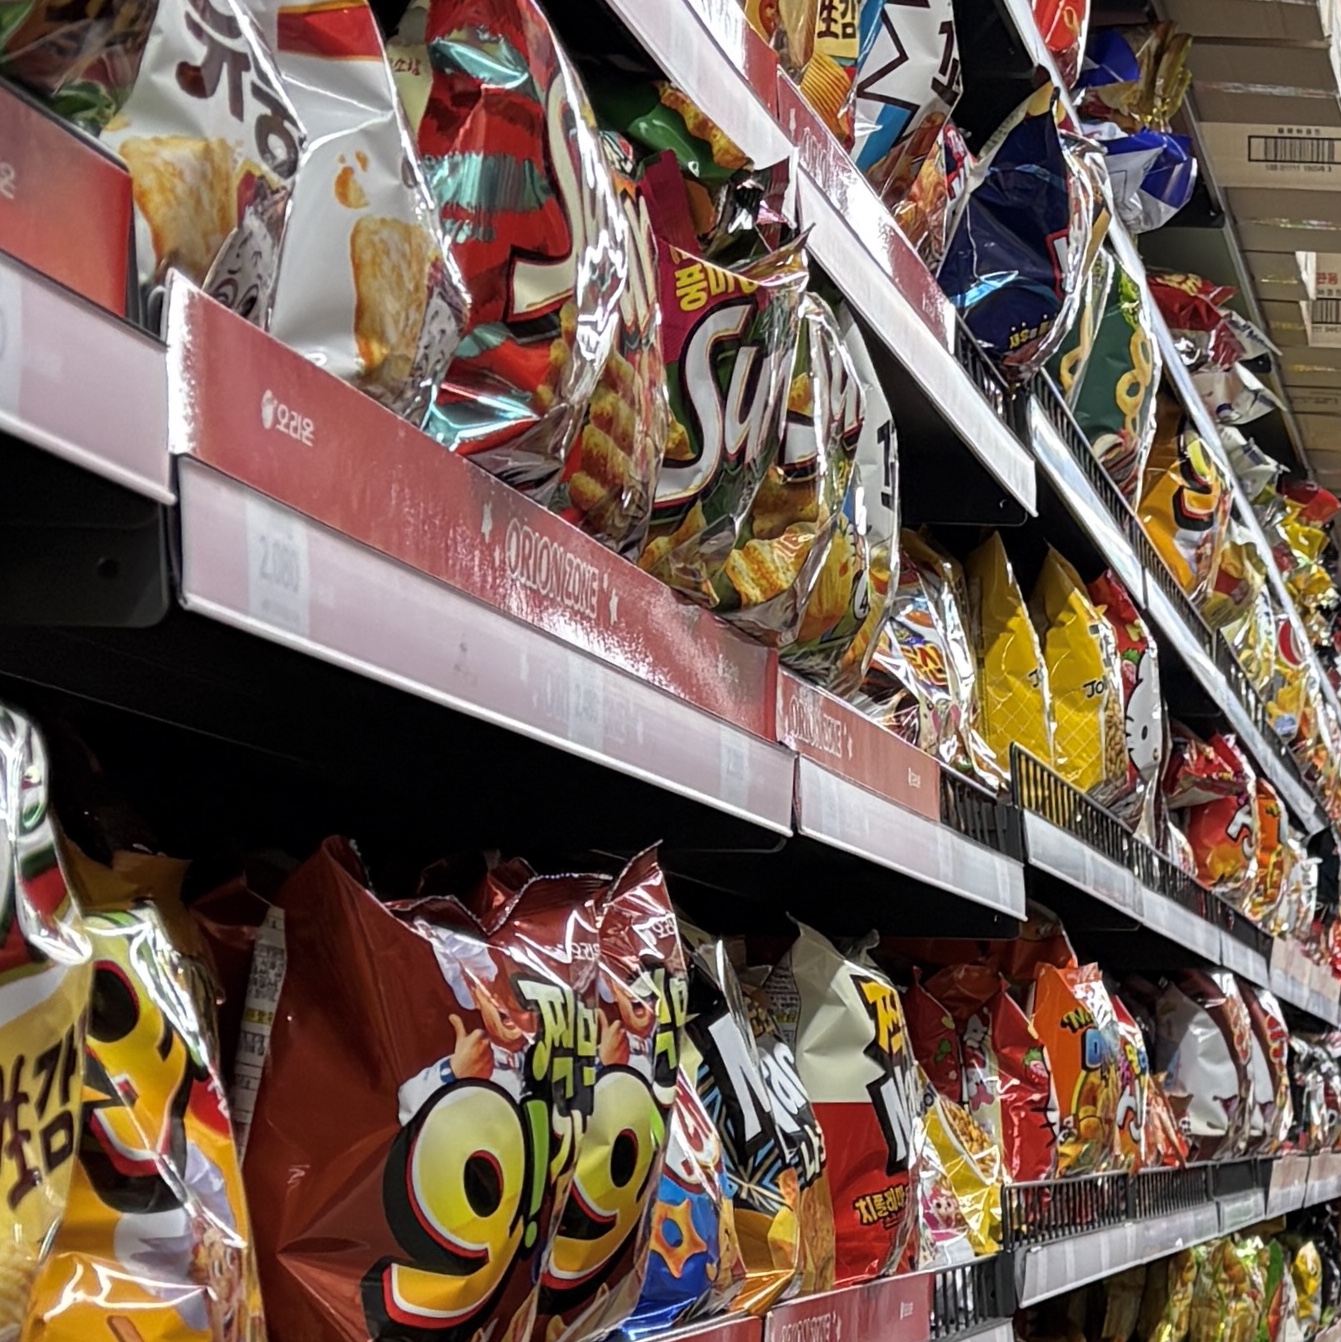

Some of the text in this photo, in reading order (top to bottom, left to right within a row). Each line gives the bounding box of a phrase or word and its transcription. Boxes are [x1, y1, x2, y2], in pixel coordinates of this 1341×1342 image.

[275, 397, 315, 447] 오리온
[505, 517, 600, 620] ORION ZONE
